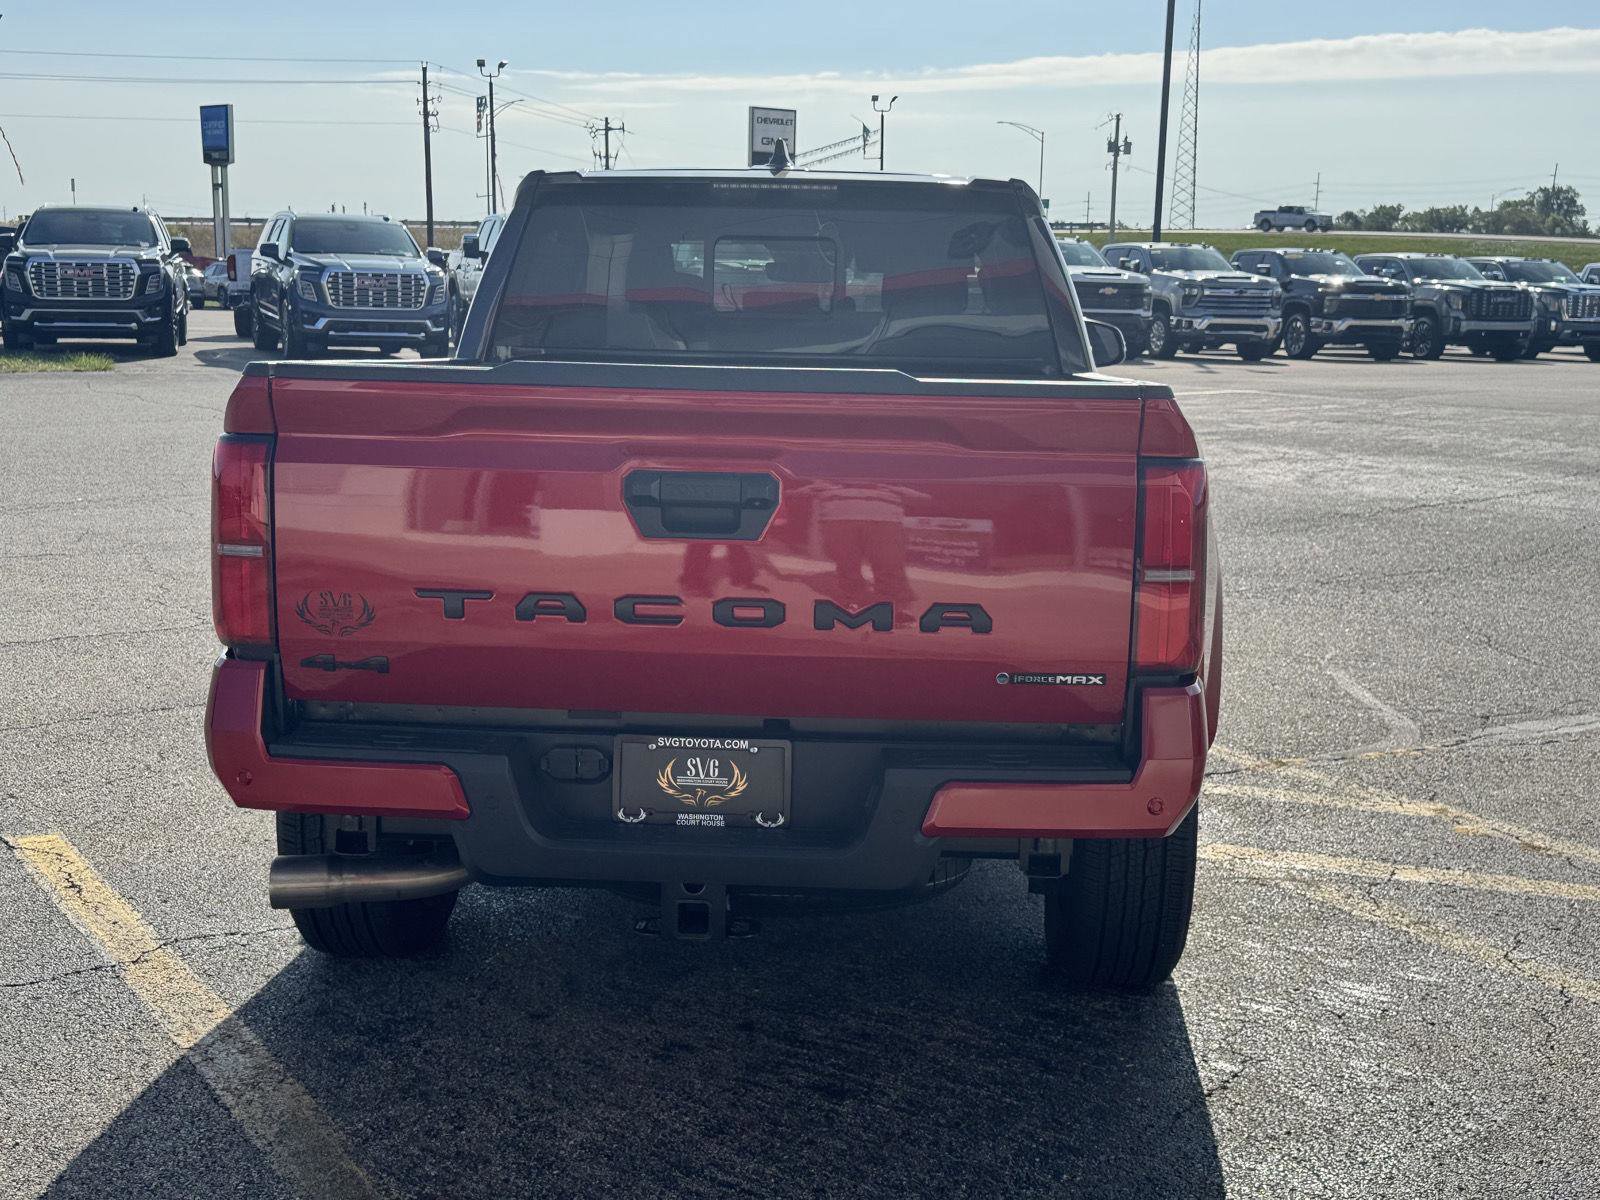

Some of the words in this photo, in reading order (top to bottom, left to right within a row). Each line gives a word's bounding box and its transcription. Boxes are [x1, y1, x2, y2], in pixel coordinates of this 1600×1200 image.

[757, 116, 793, 126] CHEVROLET
[319, 591, 352, 608] SVG
[413, 588, 993, 634] TACOMA
[657, 737, 749, 749] SVGTOYOTA.COM
[686, 757, 719, 780] SVG
[677, 813, 724, 821] WASHINGTON
